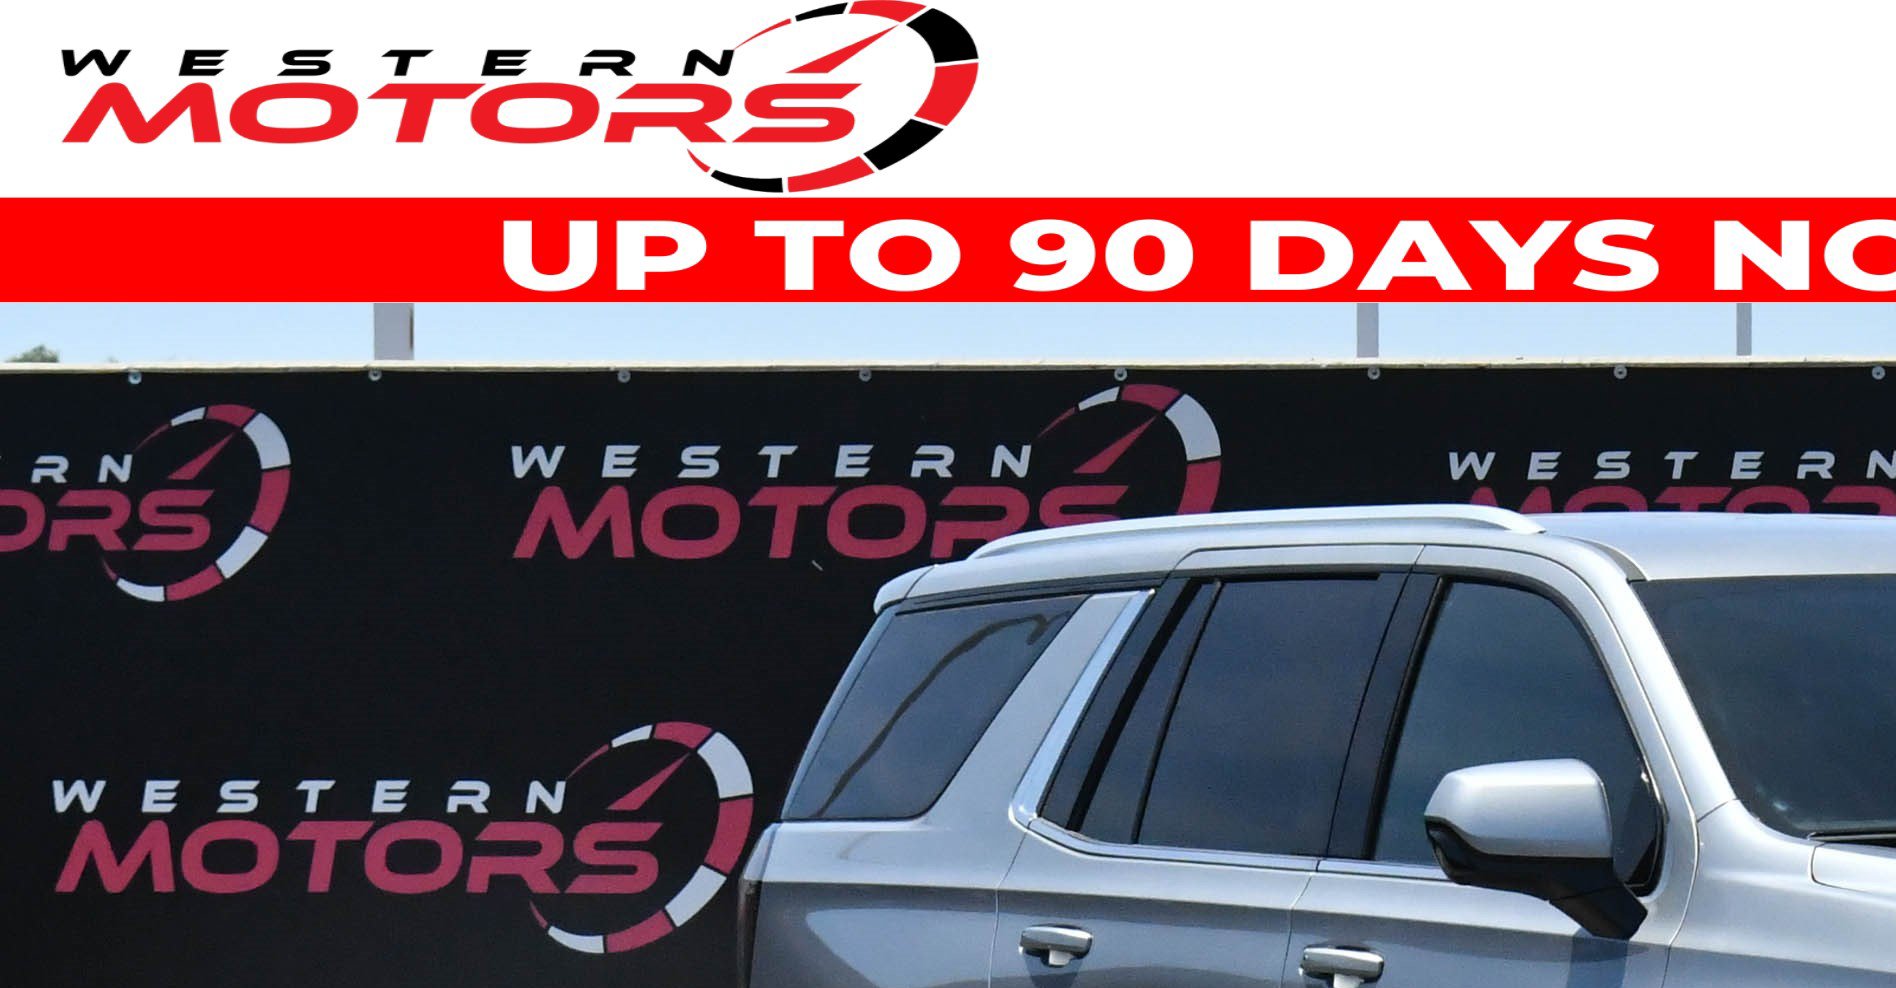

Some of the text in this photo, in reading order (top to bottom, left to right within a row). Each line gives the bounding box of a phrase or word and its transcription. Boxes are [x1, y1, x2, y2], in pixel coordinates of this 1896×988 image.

[511, 444, 1032, 479] WESTERN
[52, 779, 566, 814] WESTERN
[56, 819, 662, 894] MOTORS
